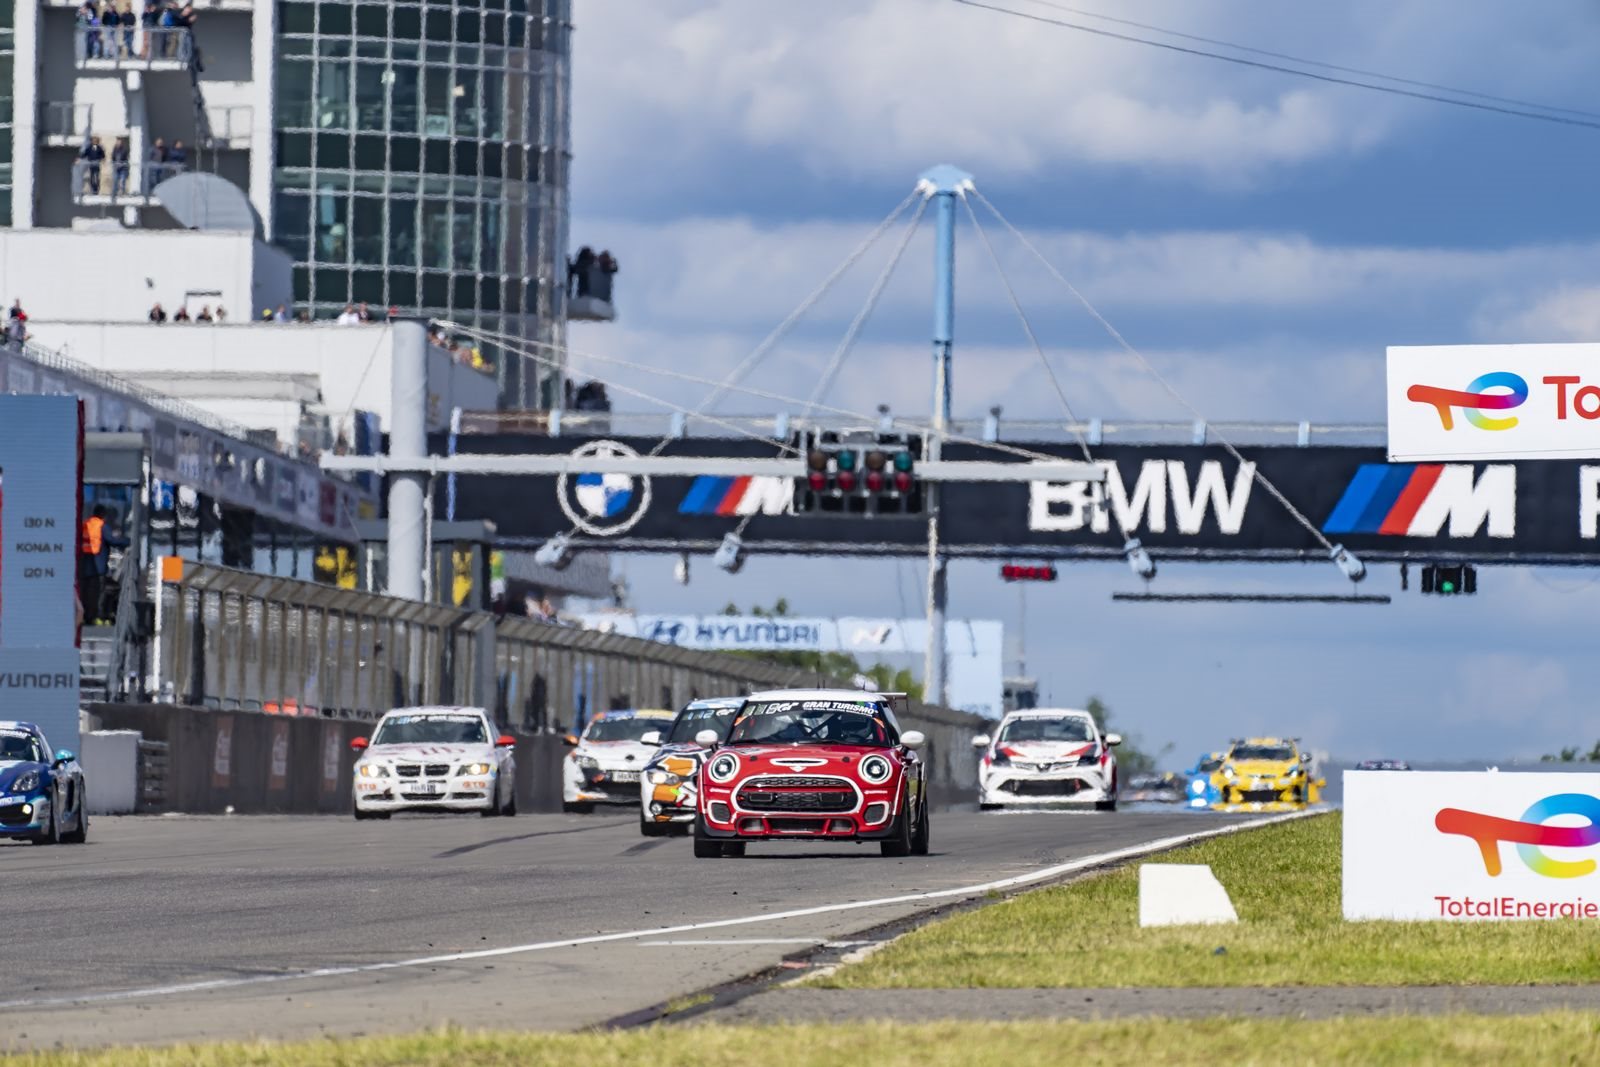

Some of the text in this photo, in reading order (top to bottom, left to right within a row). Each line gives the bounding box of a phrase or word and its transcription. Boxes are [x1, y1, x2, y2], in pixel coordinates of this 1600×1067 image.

[1543, 375, 1600, 420] To
[1029, 459, 1257, 535] BMW
[45, 517, 55, 528] N
[16, 542, 63, 553] KONA N
[45, 567, 54, 578] N
[696, 623, 818, 644] HYUNDAI
[832, 702, 875, 715] TURISMO
[1435, 896, 1598, 918] TotalEnergie
